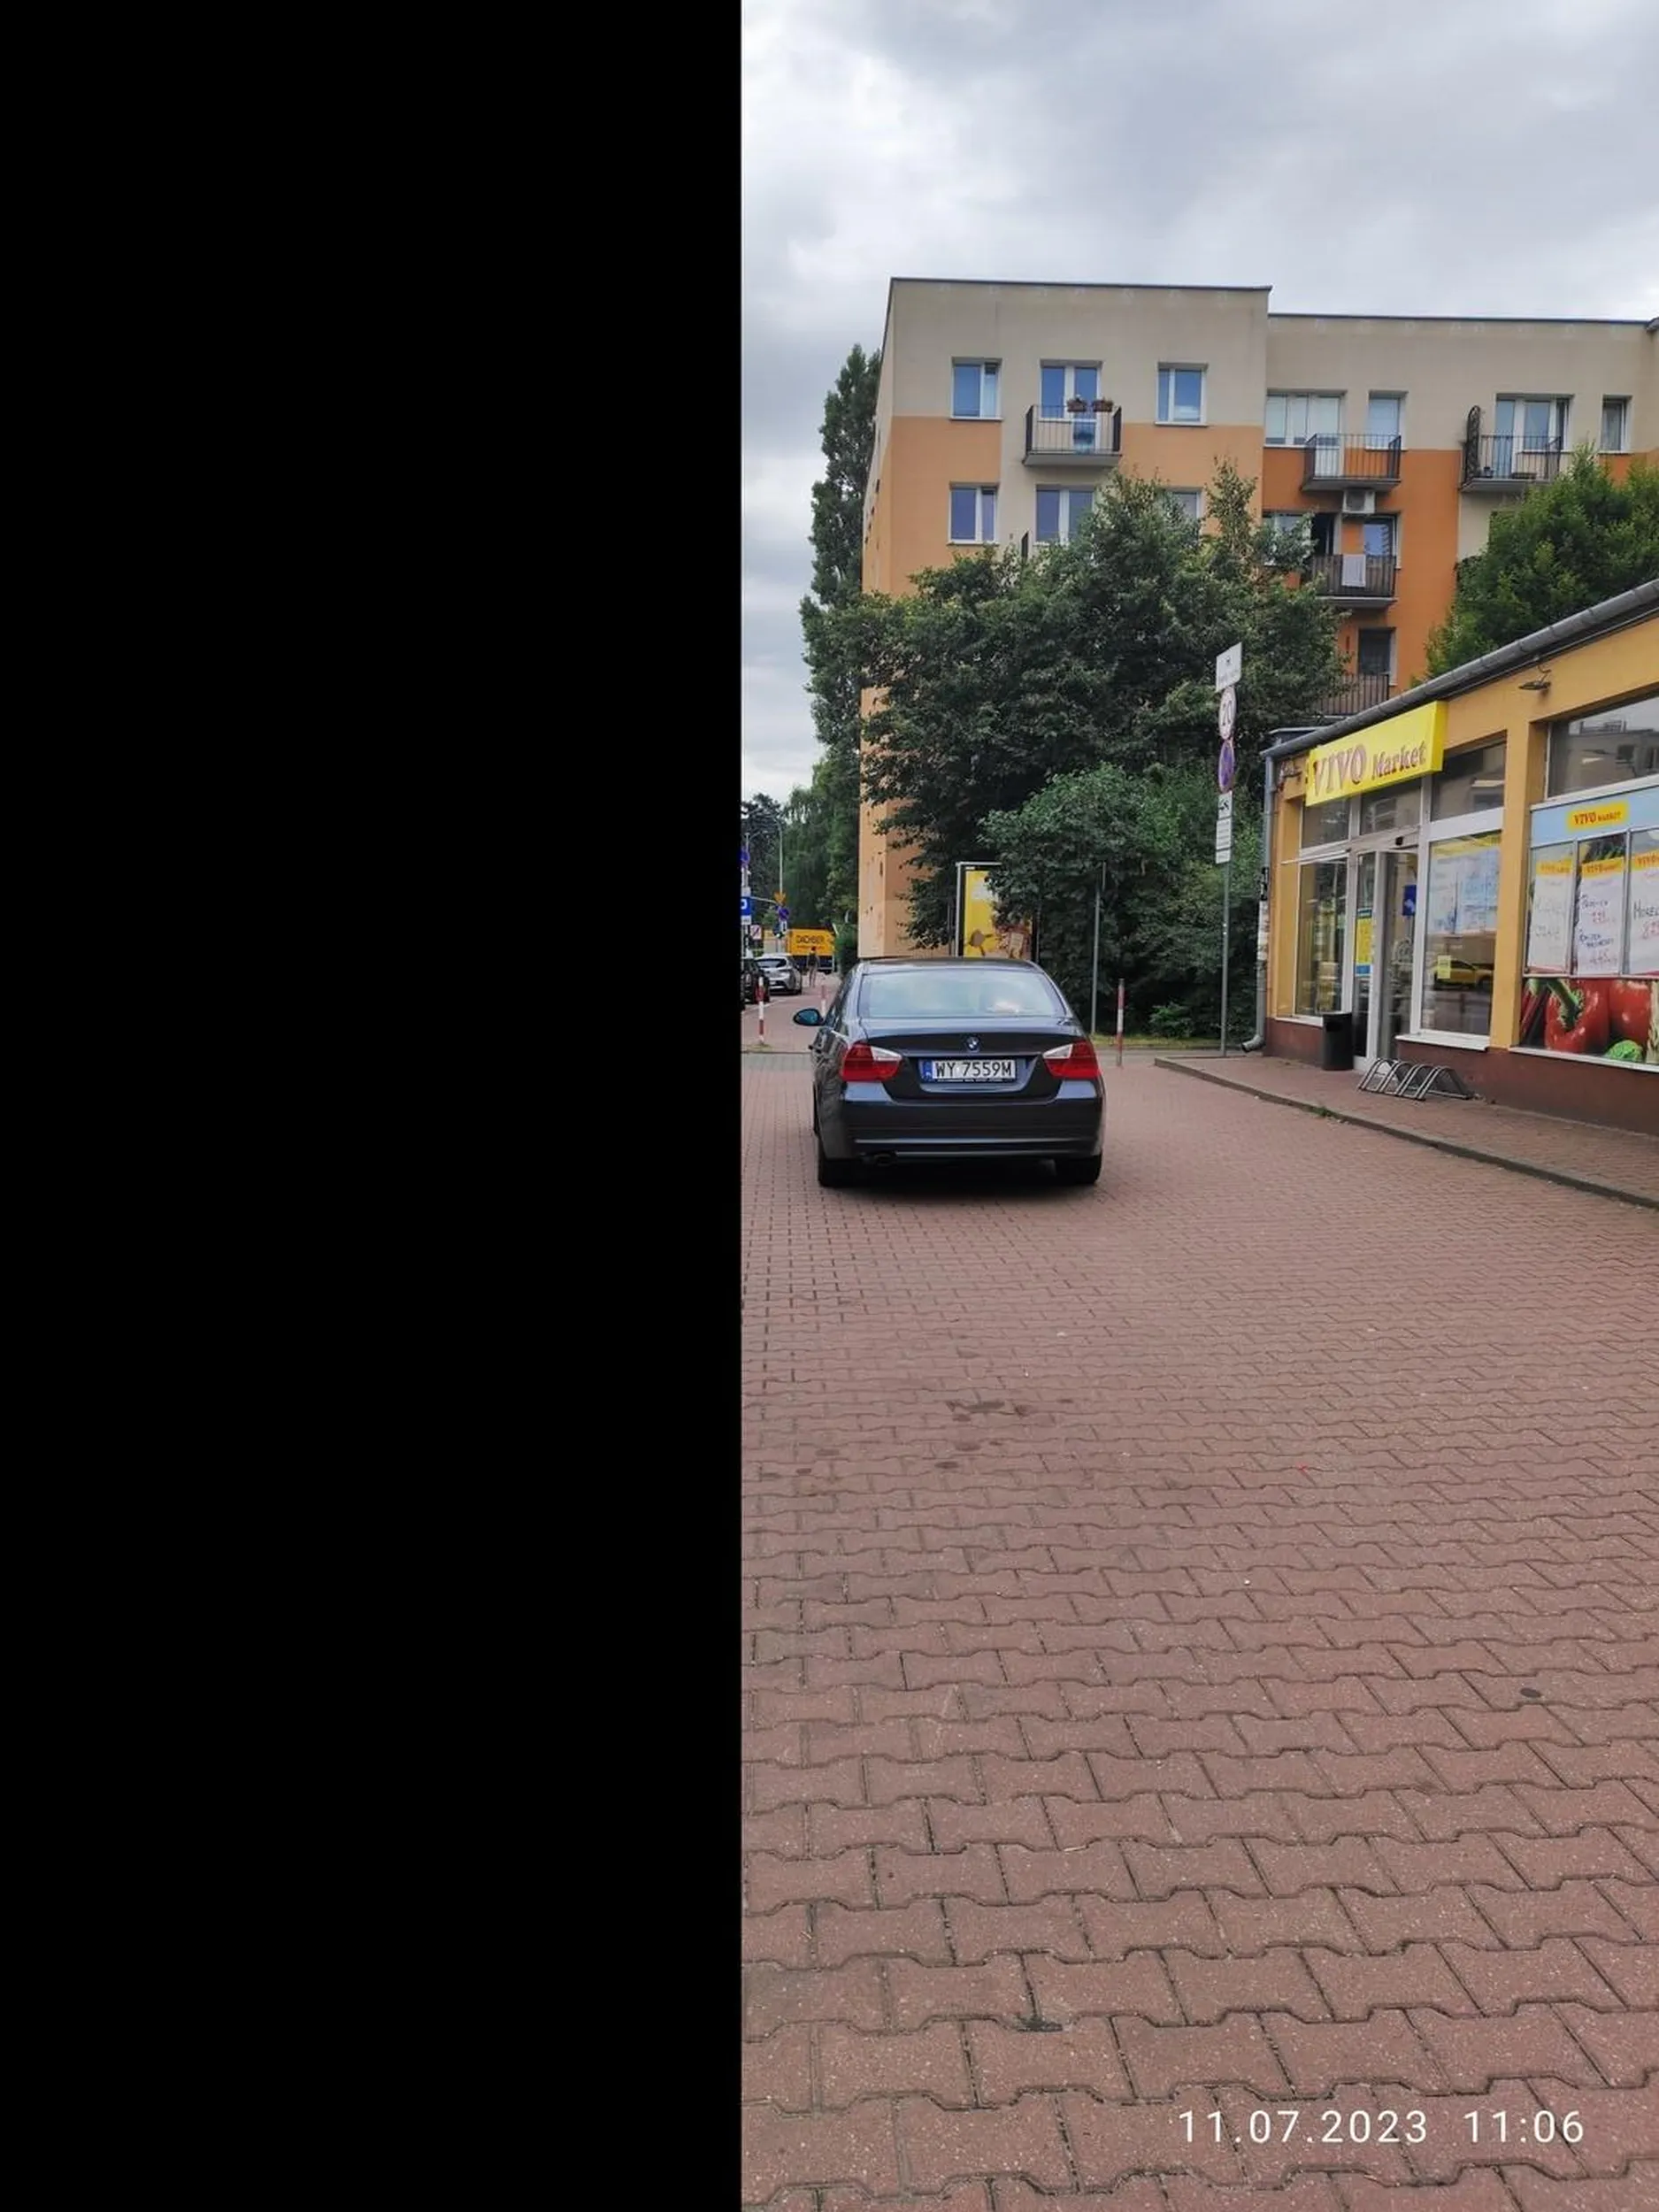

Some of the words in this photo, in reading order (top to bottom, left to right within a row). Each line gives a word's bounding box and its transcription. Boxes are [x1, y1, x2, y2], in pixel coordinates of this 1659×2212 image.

[1313, 744, 1367, 796] VIVO
[1372, 741, 1427, 780] Market
[1574, 811, 1596, 826] VIVO
[935, 1062, 956, 1077] WY
[963, 1062, 1011, 1077] 7559M
